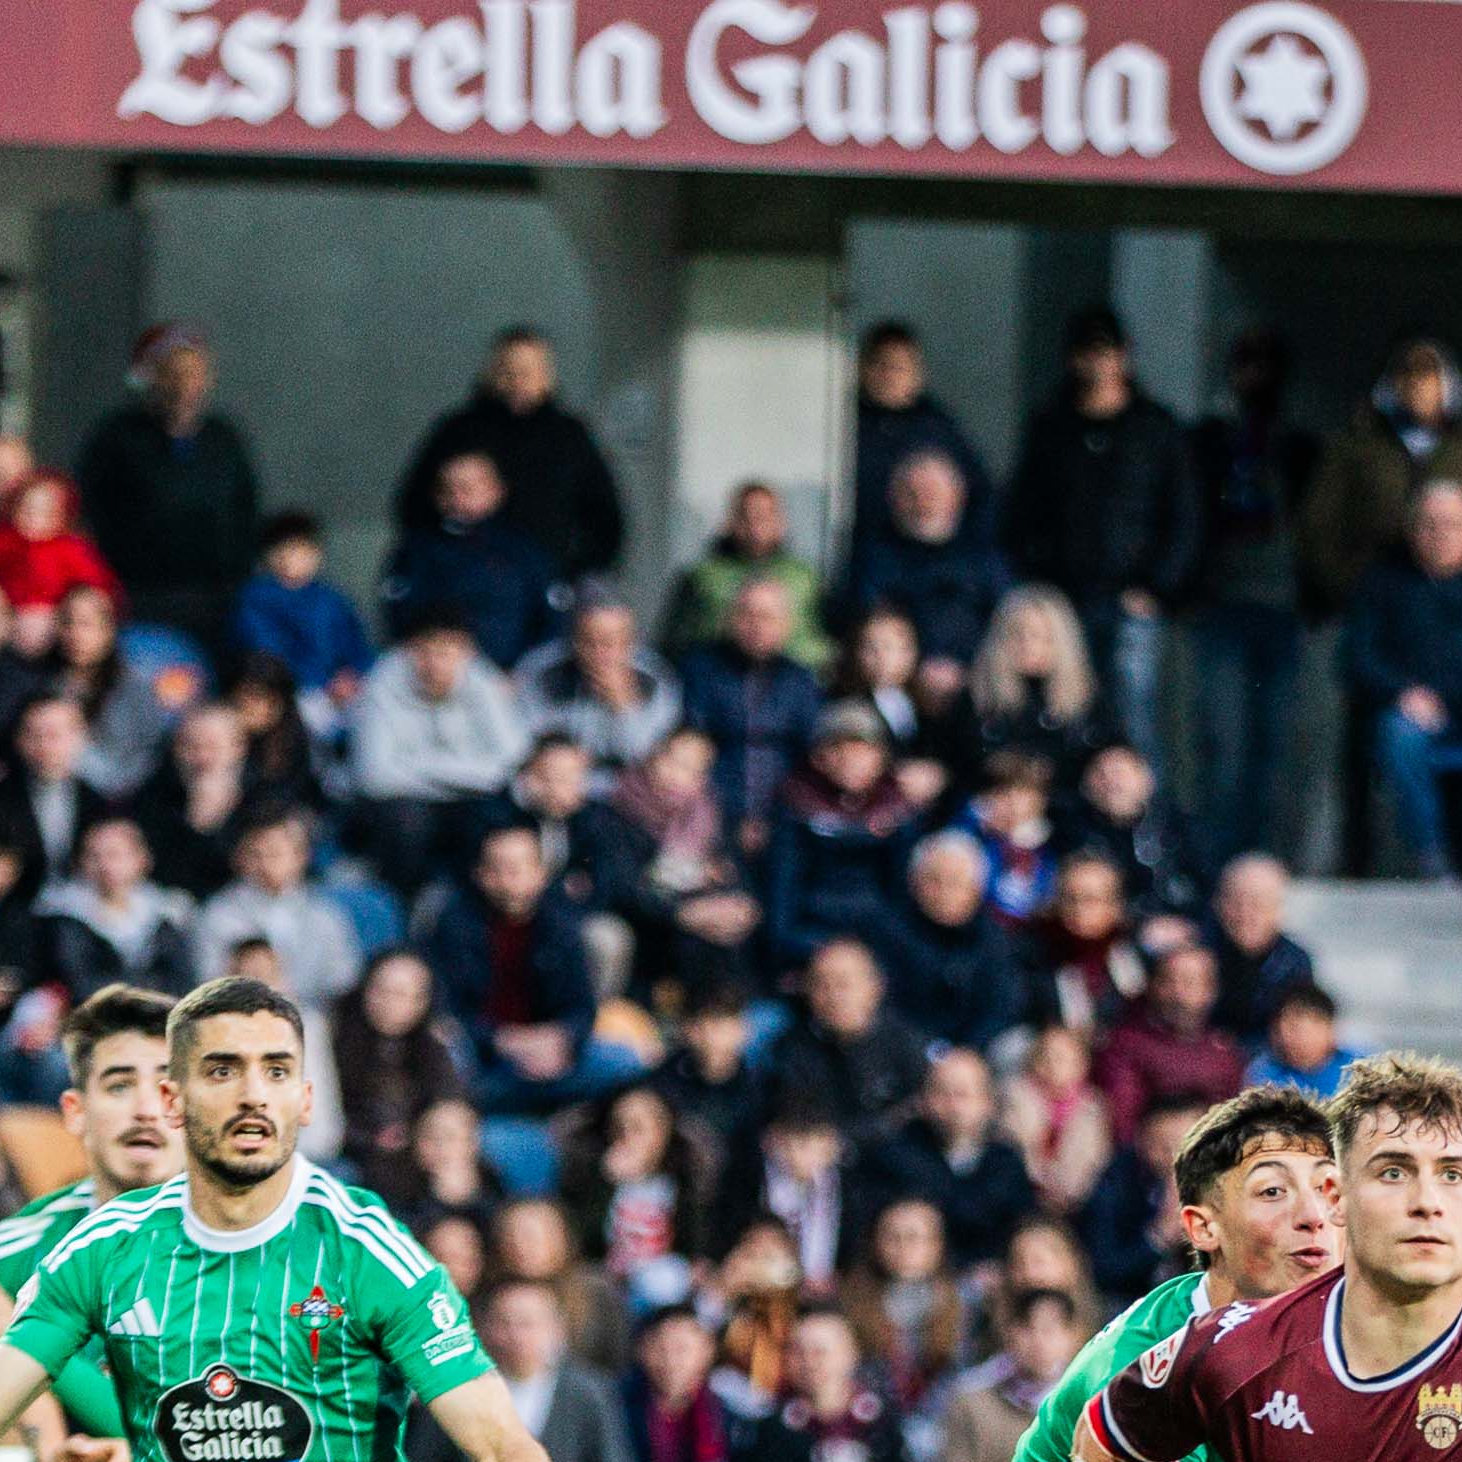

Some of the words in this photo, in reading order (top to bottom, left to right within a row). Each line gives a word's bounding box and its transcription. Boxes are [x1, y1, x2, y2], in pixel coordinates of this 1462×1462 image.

[115, 0, 667, 136] Estrella
[685, 0, 1175, 157] Galicia
[171, 1400, 286, 1432] Estrella
[179, 1430, 285, 1462] Galicia
